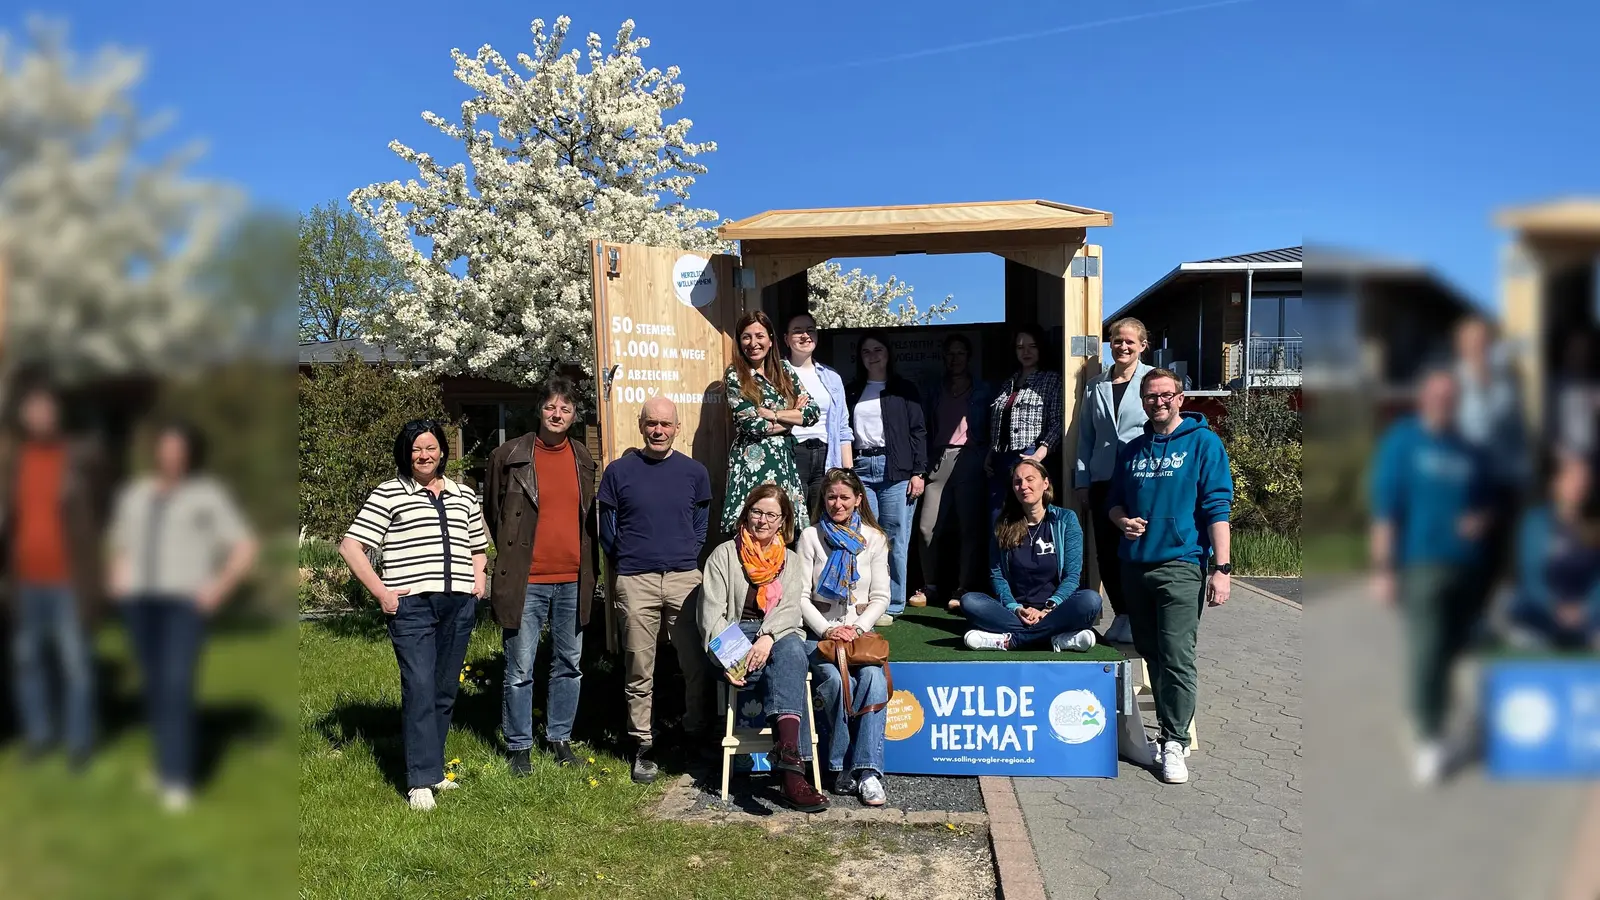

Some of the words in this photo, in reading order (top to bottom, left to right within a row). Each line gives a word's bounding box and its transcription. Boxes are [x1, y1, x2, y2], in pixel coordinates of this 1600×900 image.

[680, 270, 706, 279] HERZLICH
[611, 316, 633, 334] 50
[635, 323, 676, 336] STEMPEL
[613, 339, 659, 358] 1.000
[662, 348, 678, 359] KM
[681, 349, 706, 361] WEGE
[627, 369, 679, 381] ABZEICHEN
[616, 386, 646, 404] 100
[926, 685, 1035, 718] WILDE
[930, 723, 1038, 752] HEIMAT
[932, 755, 1036, 765] www.solling-vogler-region.de
